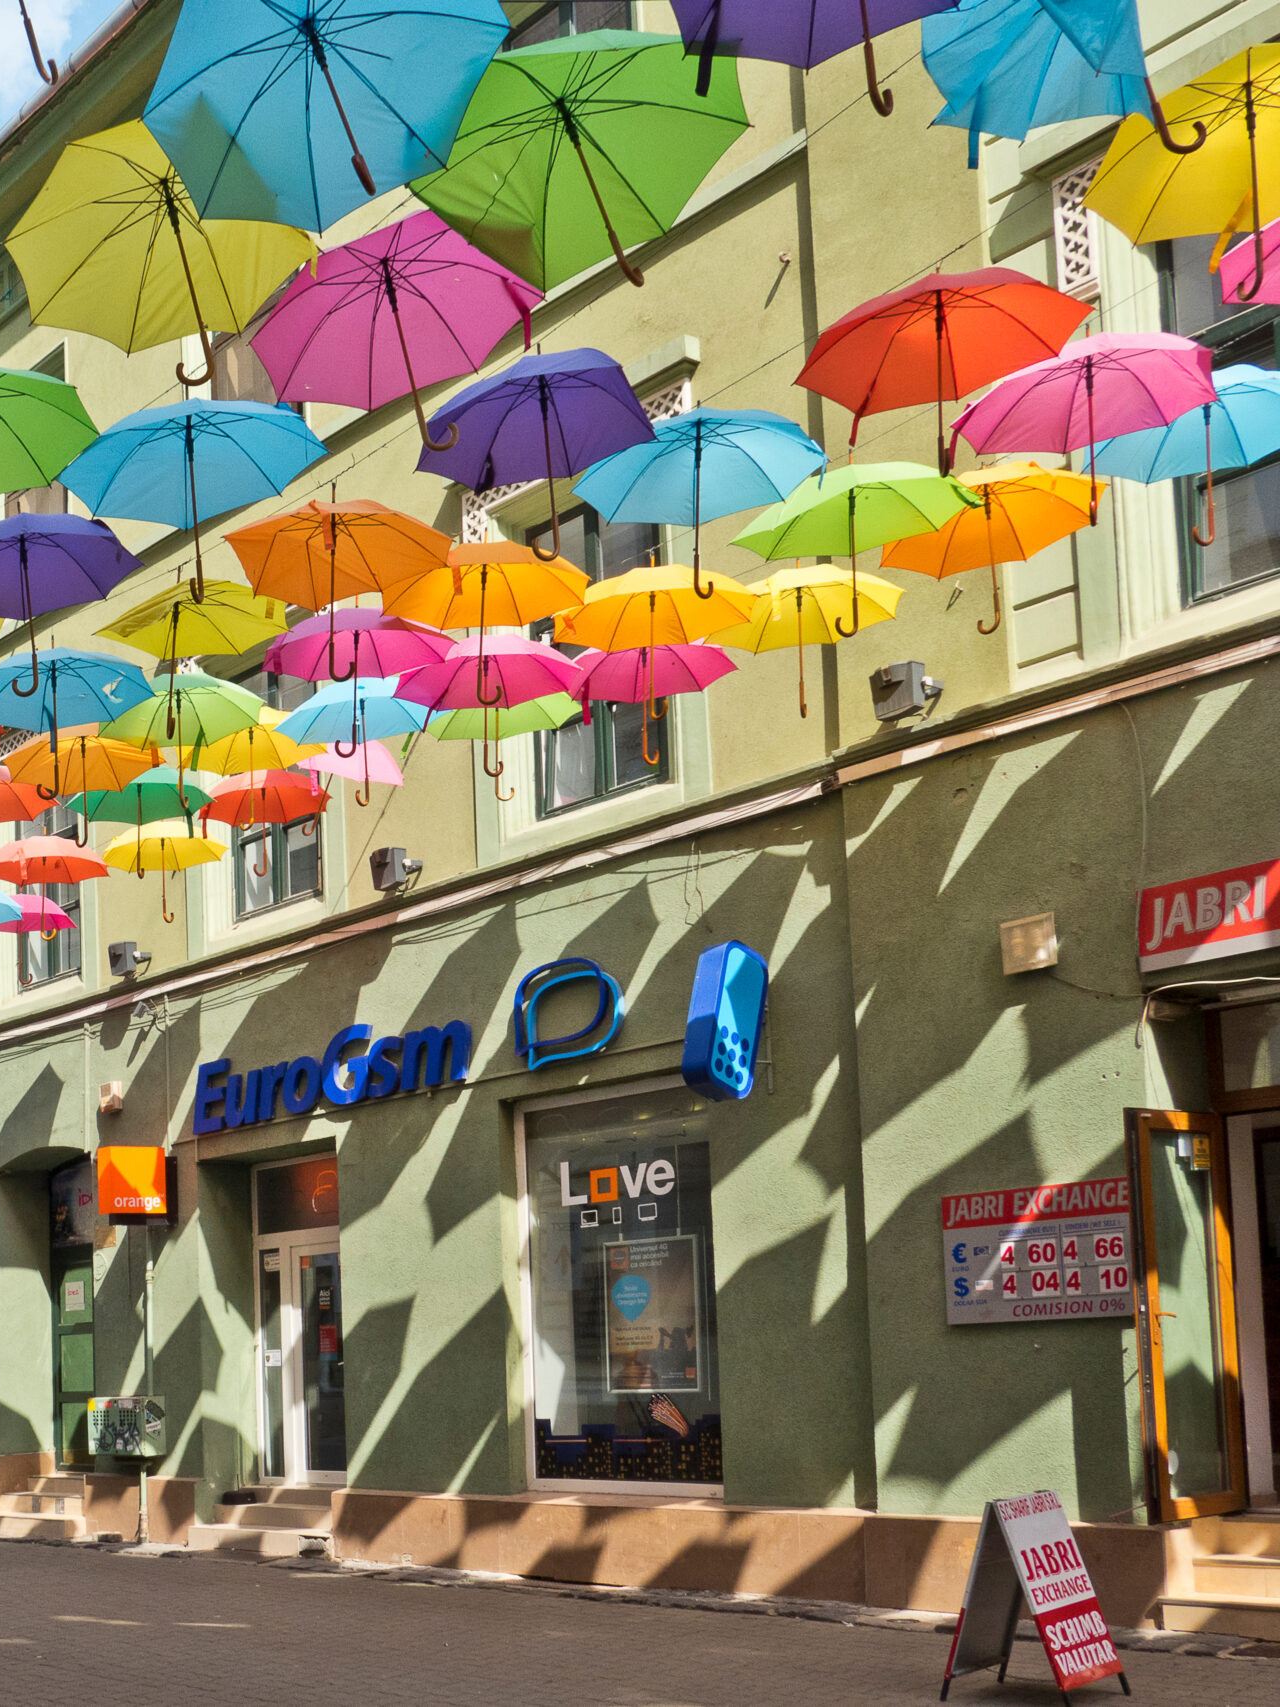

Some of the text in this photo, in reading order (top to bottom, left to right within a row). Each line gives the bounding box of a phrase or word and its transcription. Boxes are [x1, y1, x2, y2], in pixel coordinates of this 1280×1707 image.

[1145, 874, 1268, 952] JABRI
[193, 1019, 473, 1136] EuroGsm
[114, 1196, 161, 1212] orange
[946, 1180, 1129, 1227] JABRI EXCHANGE
[1000, 1245, 1015, 1265] 4
[1028, 1243, 1056, 1264] 60
[1063, 1240, 1078, 1260] 4
[1095, 1236, 1124, 1259] 66
[1002, 1274, 1017, 1294] 4
[1032, 1271, 1060, 1292] 04
[1066, 1271, 1081, 1291] 4
[1100, 1267, 1128, 1290] 10
[1013, 1299, 1126, 1317] COMISION 0%
[1021, 1538, 1083, 1582] JABRI
[1031, 1574, 1091, 1606] EXCHANGE
[1045, 1610, 1108, 1651] SCHIMB
[1054, 1639, 1118, 1677] VALUTAR
